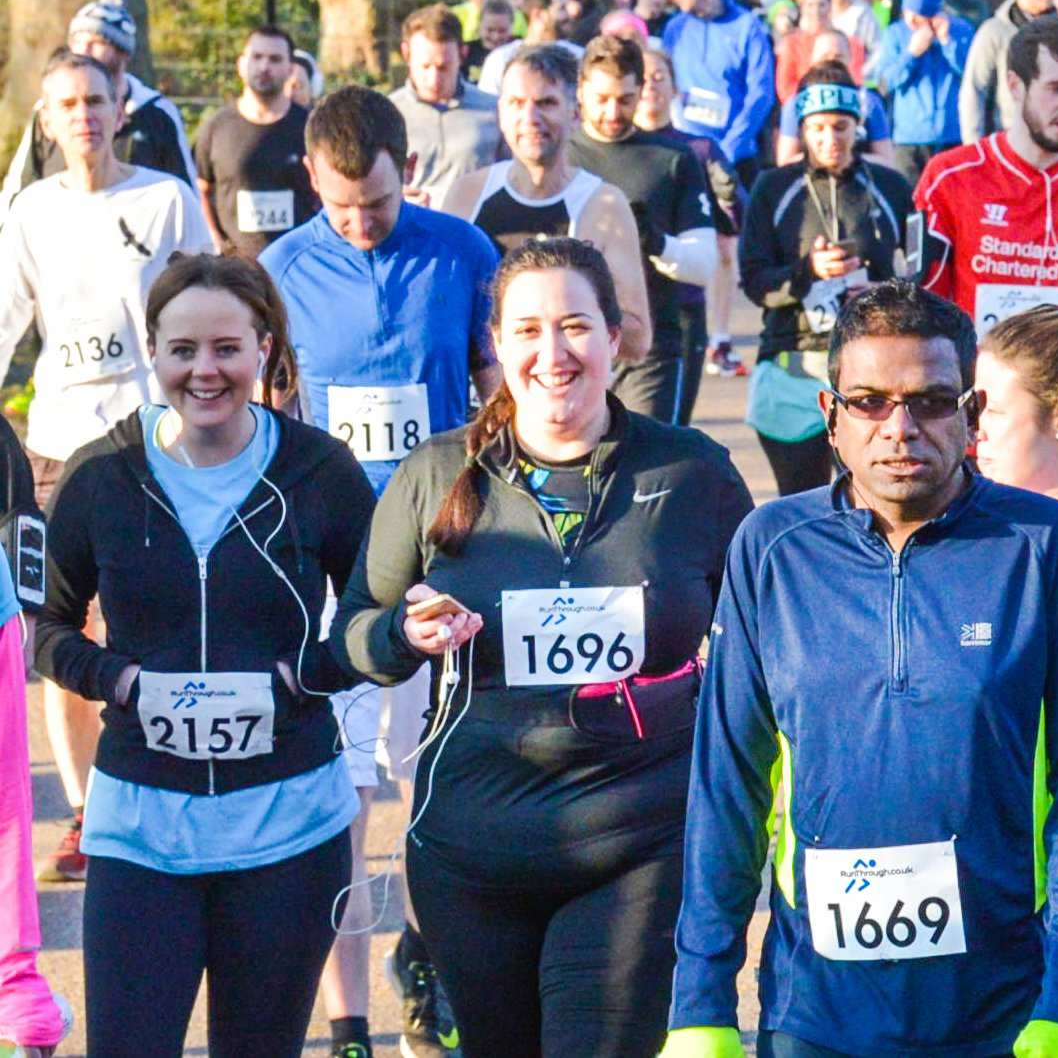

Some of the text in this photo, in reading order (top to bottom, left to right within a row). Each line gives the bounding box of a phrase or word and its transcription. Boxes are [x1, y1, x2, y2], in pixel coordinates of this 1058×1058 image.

[60, 332, 124, 367] 2136
[338, 419, 420, 452] 2118
[522, 631, 634, 674] 1696
[150, 715, 263, 754] 2157
[840, 865, 914, 878] RunThrough.co.uk
[827, 897, 951, 950] 1669
